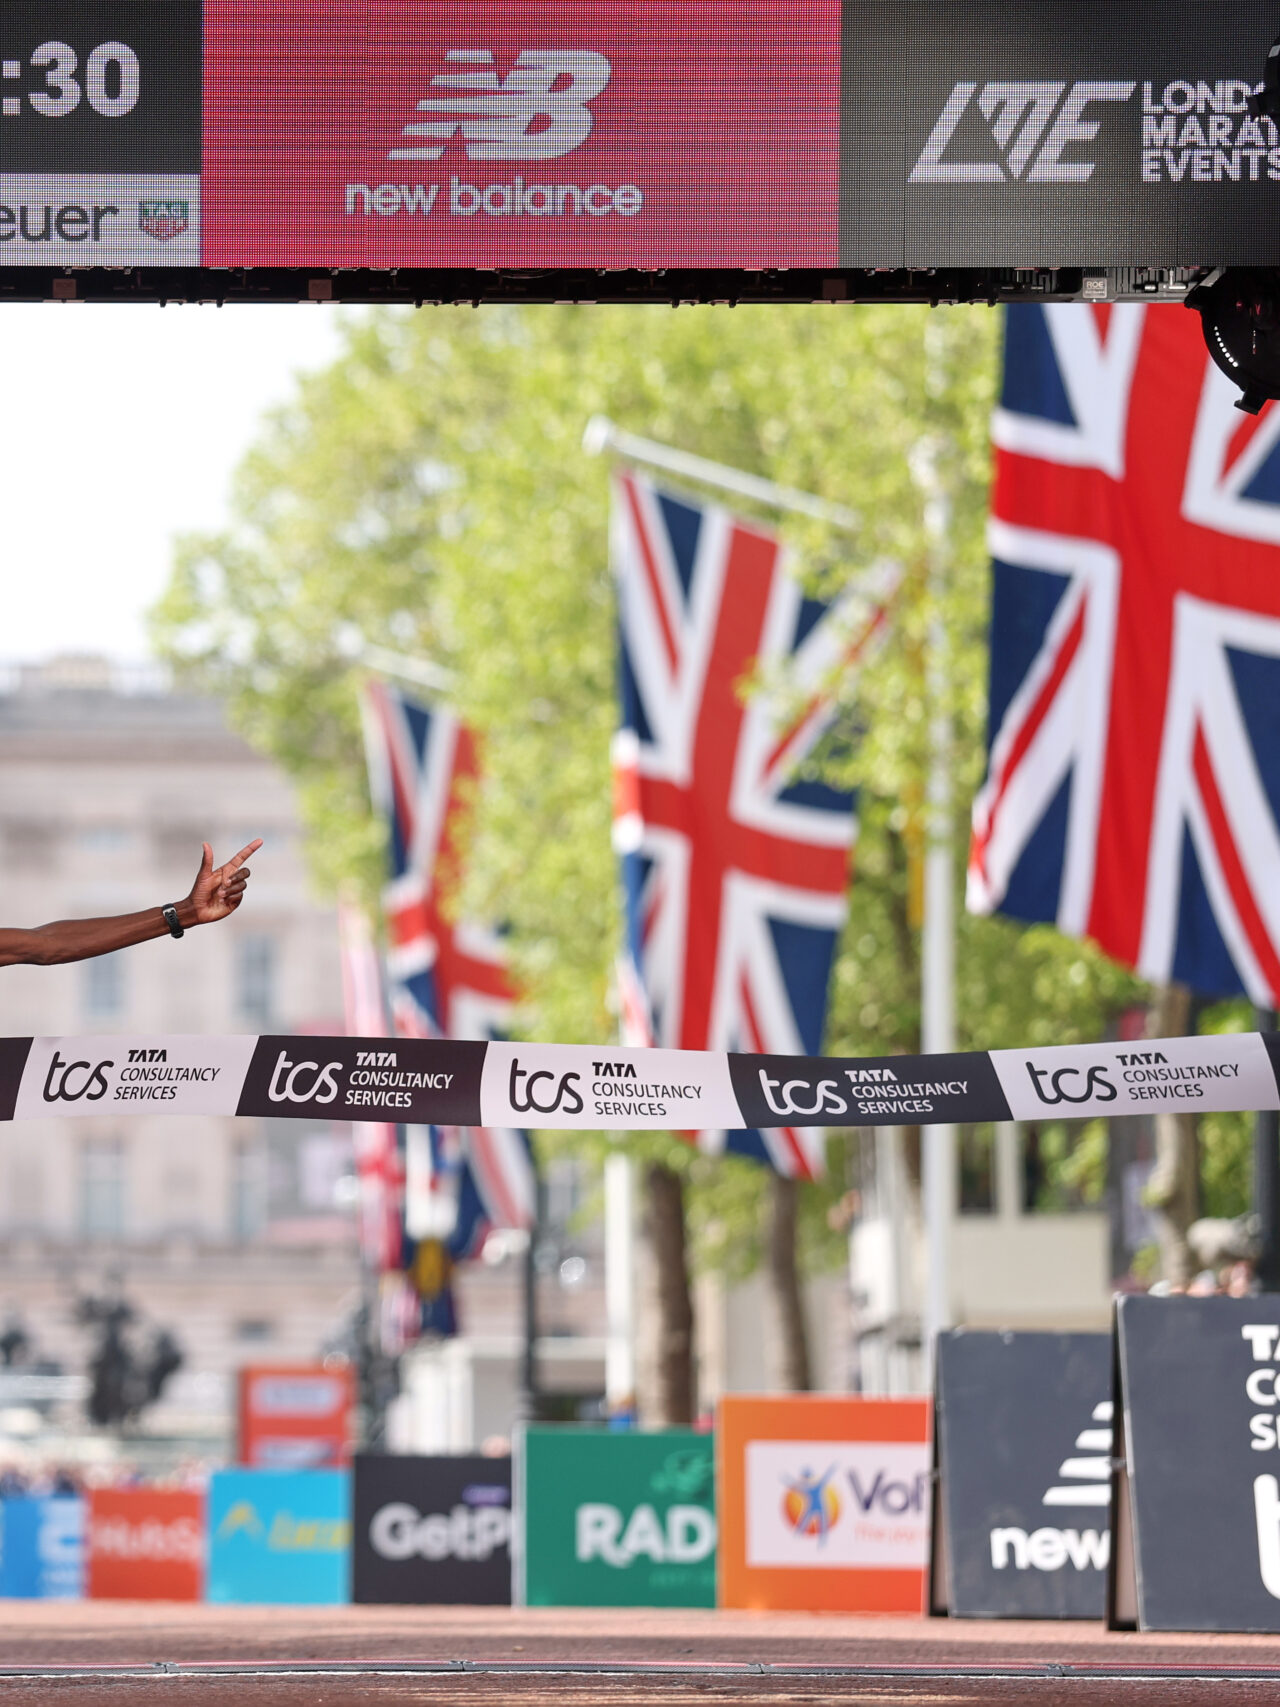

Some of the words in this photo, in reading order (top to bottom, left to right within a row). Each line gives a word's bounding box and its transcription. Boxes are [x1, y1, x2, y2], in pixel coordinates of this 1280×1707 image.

[1142, 80, 1266, 114] LOND
[344, 183, 440, 216] new
[450, 176, 646, 217] balance
[127, 1049, 167, 1063] TATA
[356, 1052, 397, 1068] TATA
[1116, 1052, 1169, 1066] TATA
[43, 1051, 114, 1101] tcs
[119, 1067, 221, 1083] CONSULTANCY
[268, 1050, 343, 1104] tcs
[592, 1062, 637, 1078] TATA
[845, 1069, 898, 1082] TATA
[1122, 1063, 1240, 1083] CONSULTANCY
[349, 1071, 453, 1090] CONSULTANCY
[509, 1058, 584, 1115] tcs
[851, 1081, 968, 1098] CONSULTANCY
[1025, 1061, 1118, 1105] tcs
[113, 1086, 177, 1101] SERVICES
[345, 1090, 412, 1108] SERVICES
[592, 1082, 702, 1100] CONSULTANCY
[758, 1069, 848, 1115] tcs
[1128, 1084, 1204, 1100] SERVICES
[595, 1102, 667, 1116] SERVICES
[857, 1100, 934, 1114] SERVICES
[369, 1501, 512, 1560] GetP
[576, 1502, 718, 1569] RAD
[990, 1527, 1112, 1571] new
